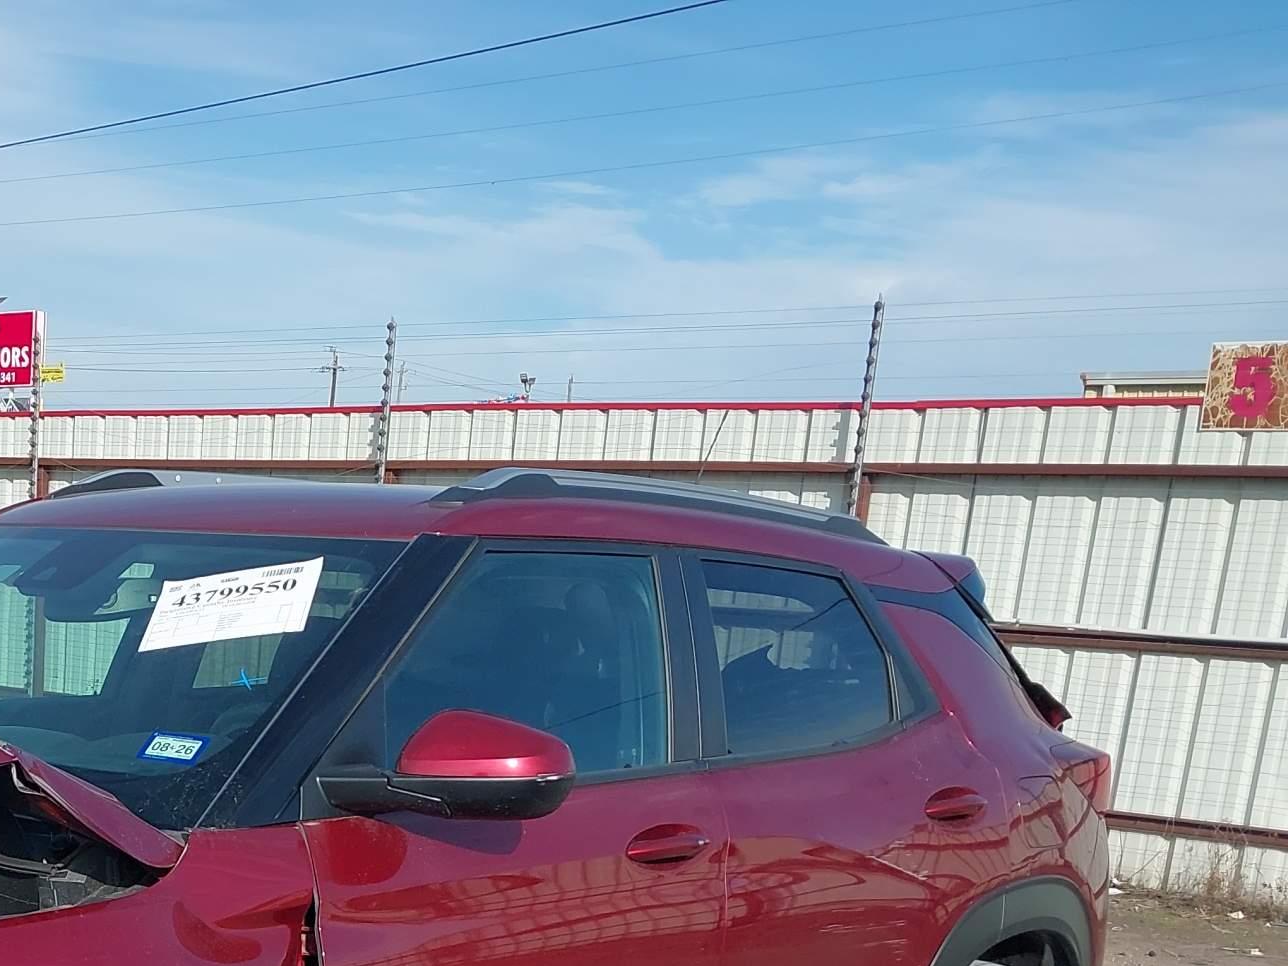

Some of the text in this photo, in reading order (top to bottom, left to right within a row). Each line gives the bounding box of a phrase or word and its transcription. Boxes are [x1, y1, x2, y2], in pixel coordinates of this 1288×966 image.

[1228, 355, 1275, 417] 5
[171, 577, 298, 608] 43799550
[151, 741, 196, 755] 08 26
